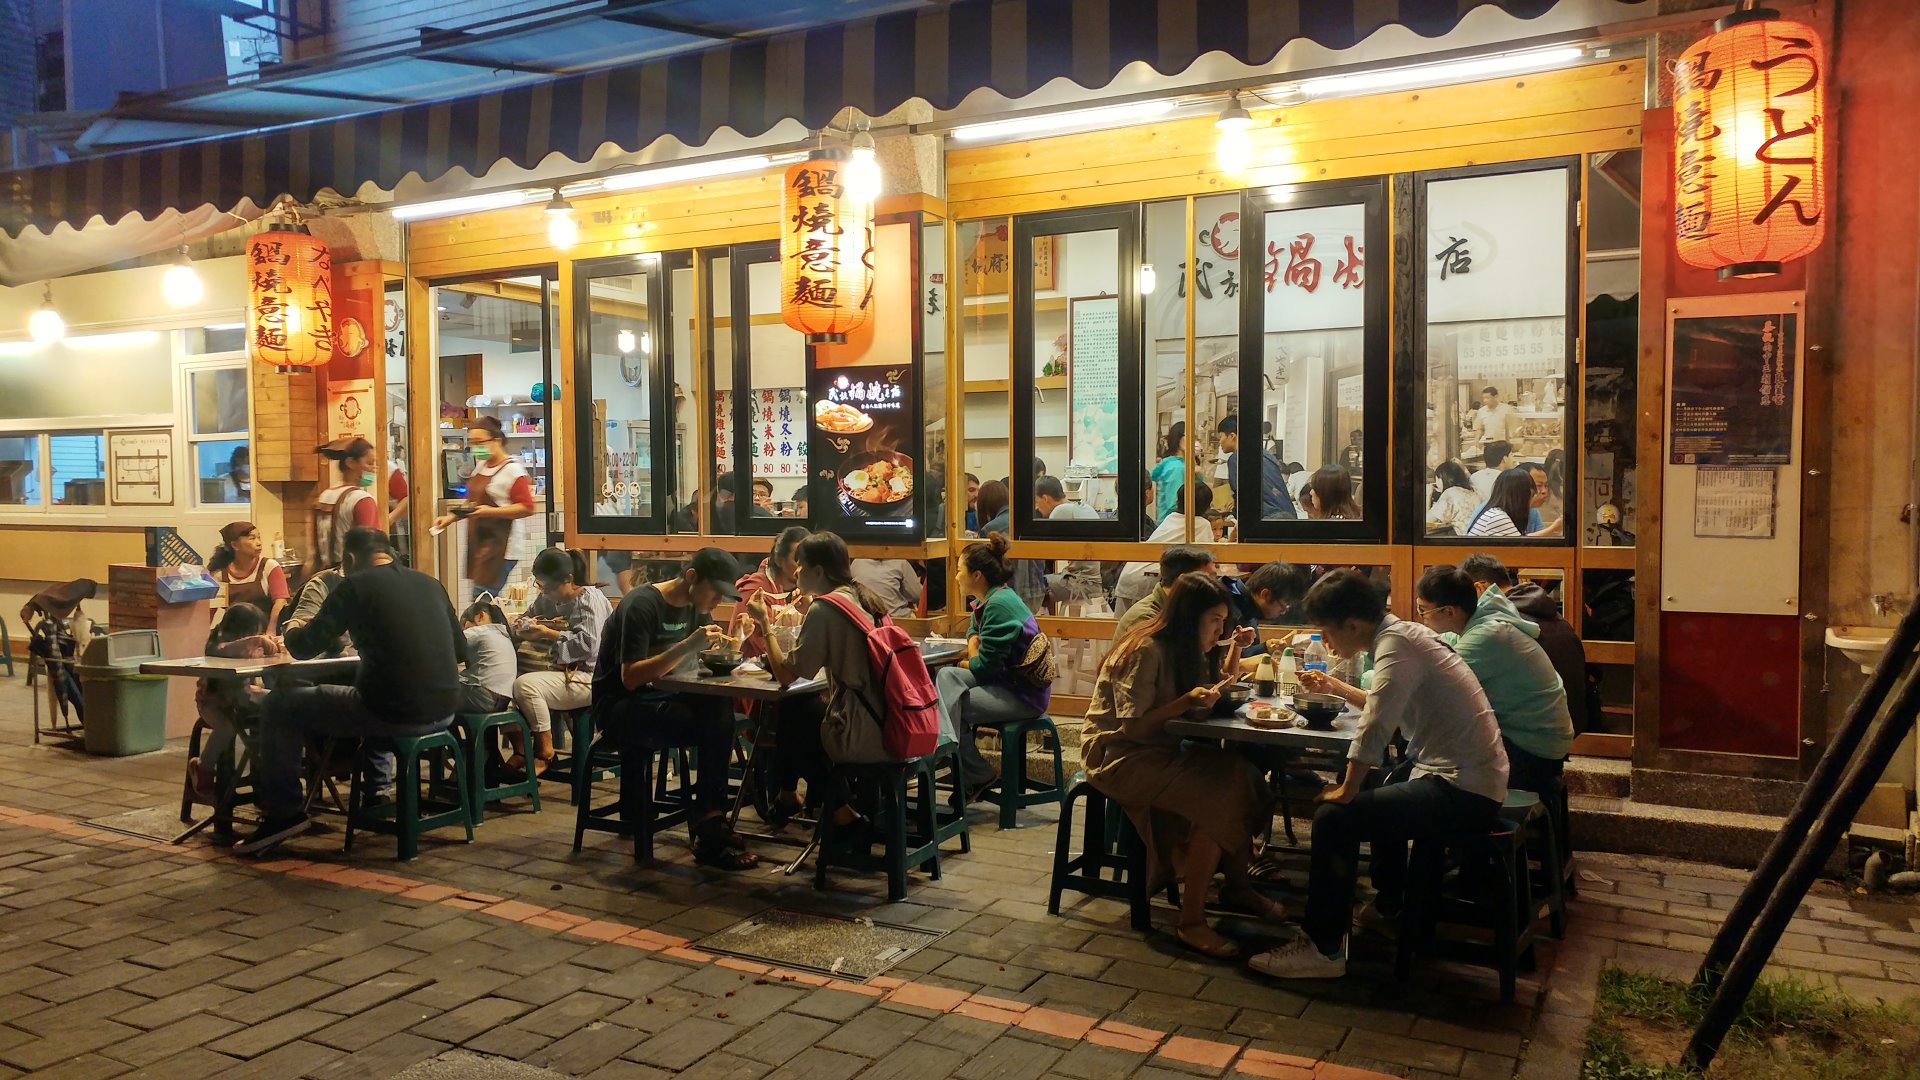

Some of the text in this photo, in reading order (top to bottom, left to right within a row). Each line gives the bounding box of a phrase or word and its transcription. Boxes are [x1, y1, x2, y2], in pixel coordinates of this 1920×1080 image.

[1676, 51, 1722, 241] 鍋燒意麵
[1750, 36, 1823, 227] うどん
[790, 168, 845, 309] 鍋燒意麵
[252, 241, 292, 352] 鍋燒意麵
[306, 246, 336, 351] なべやき
[761, 389, 776, 457] 鍋燒米粉
[763, 463, 774, 473] 80
[780, 463, 791, 473] 80
[778, 388, 793, 457] 鍋燒冬粉
